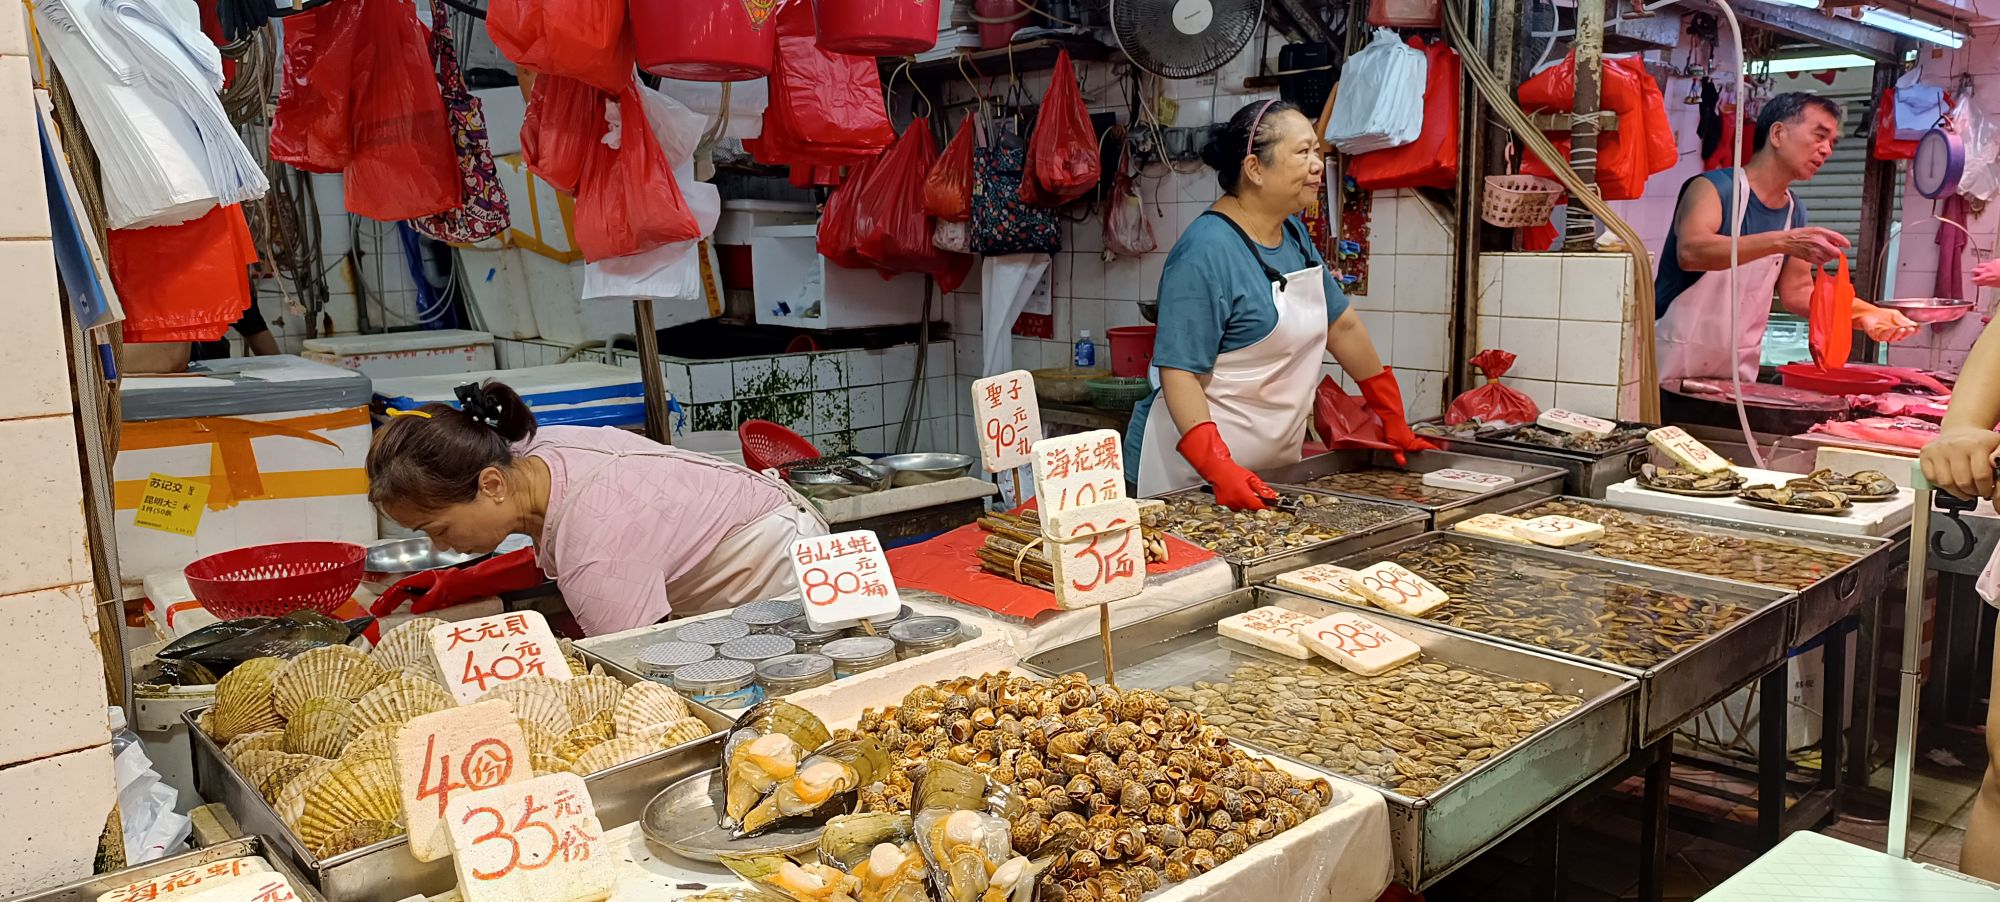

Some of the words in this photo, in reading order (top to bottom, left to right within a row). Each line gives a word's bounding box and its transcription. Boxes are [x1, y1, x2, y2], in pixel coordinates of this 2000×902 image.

[987, 418, 1015, 458] 90
[1046, 436, 1120, 479] 海花螺
[803, 568, 860, 606] 80
[1363, 570, 1422, 605] 38
[1318, 624, 1381, 657] 28
[462, 650, 524, 691] 40
[462, 795, 559, 880] 35
